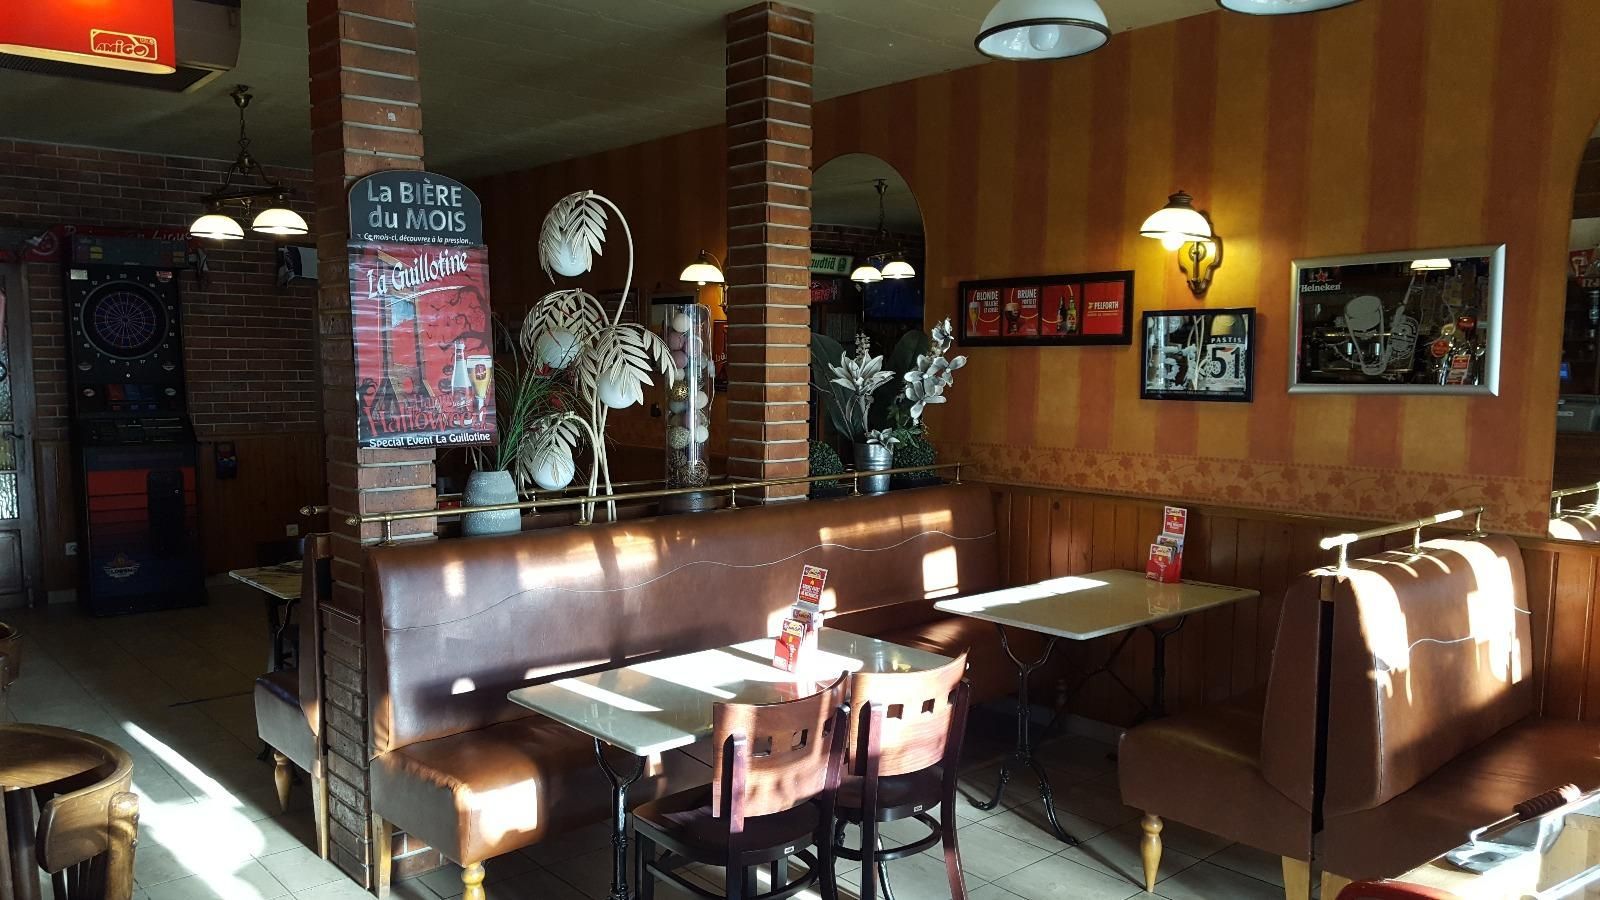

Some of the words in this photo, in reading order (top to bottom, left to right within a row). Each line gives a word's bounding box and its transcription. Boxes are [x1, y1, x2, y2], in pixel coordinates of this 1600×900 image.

[367, 179, 392, 203] La
[400, 177, 462, 207] BIÈRE
[368, 204, 398, 229] du
[405, 207, 467, 233] MOIS
[399, 235, 431, 243] découvrez
[366, 268, 387, 300] La
[391, 248, 469, 291] Guillotine
[1017, 288, 1037, 299] BRUNE
[1301, 283, 1341, 293] Heineken
[976, 290, 999, 301] BLONDE
[1094, 301, 1119, 310] PELFORTH
[1211, 336, 1242, 344] PASTIS
[1210, 346, 1241, 379] 51
[369, 436, 405, 448] Special
[406, 435, 434, 447] Event
[435, 434, 447, 444] La
[449, 431, 491, 444] Guillotine
